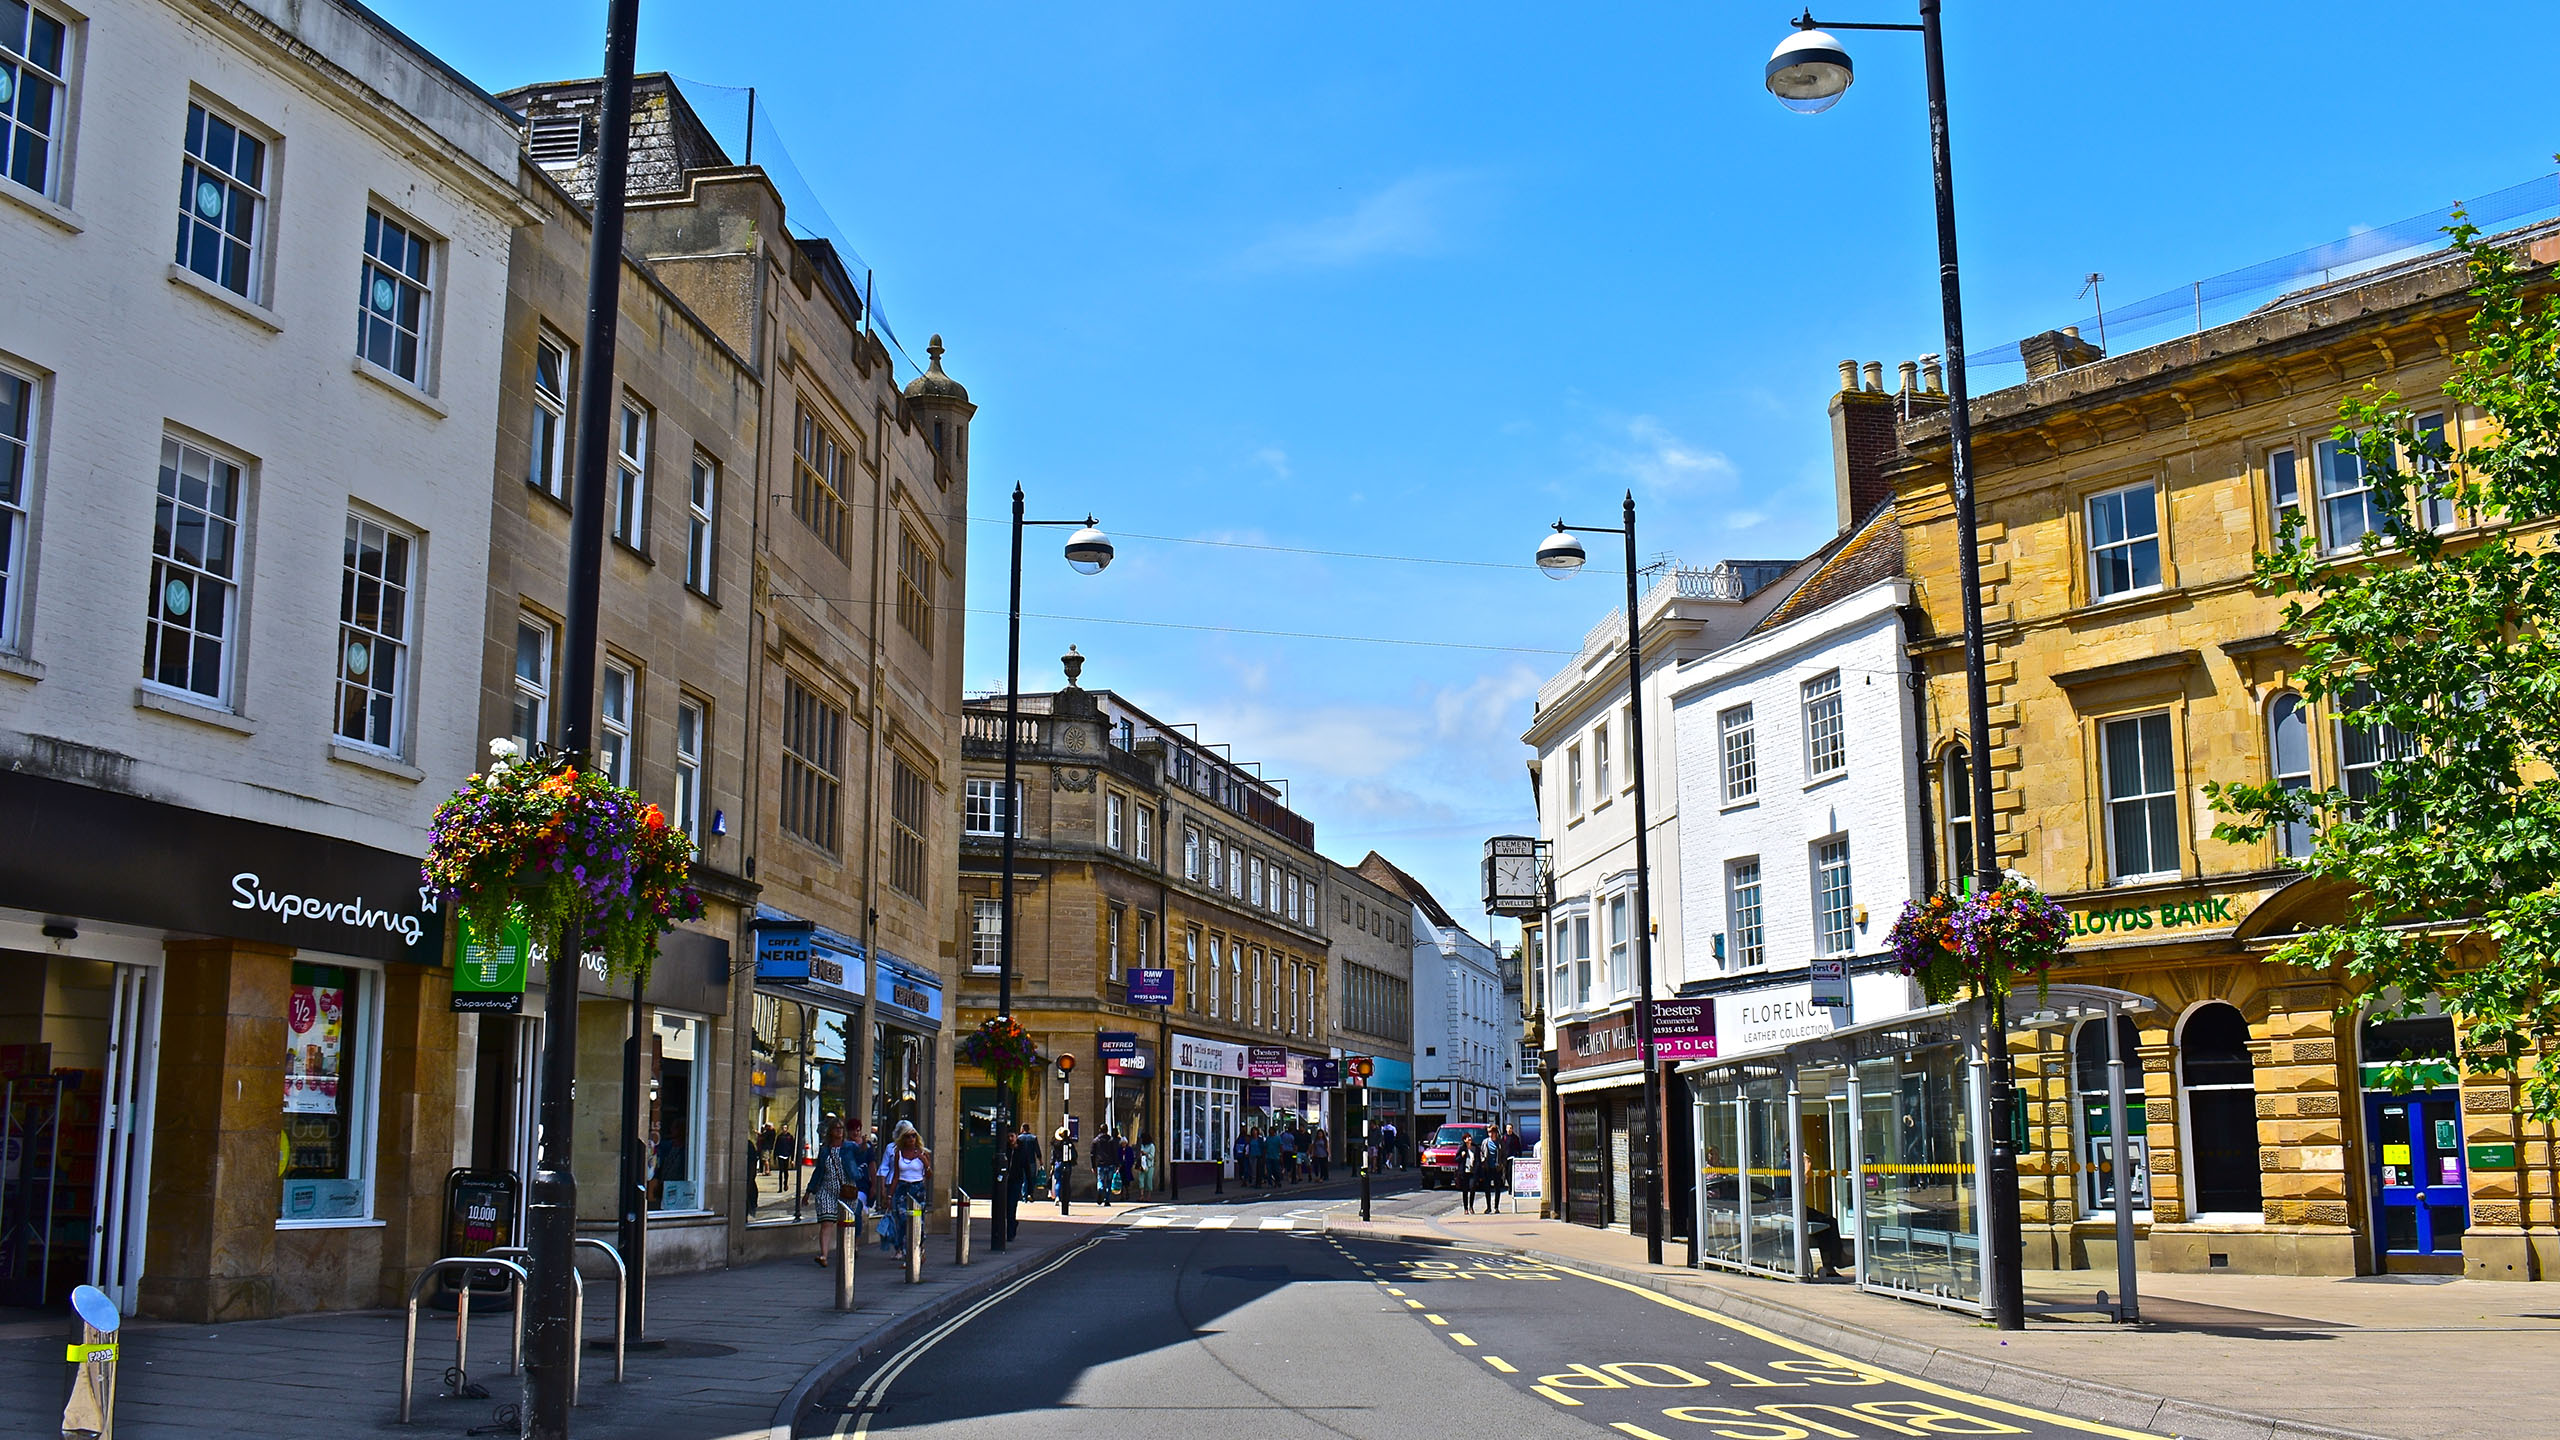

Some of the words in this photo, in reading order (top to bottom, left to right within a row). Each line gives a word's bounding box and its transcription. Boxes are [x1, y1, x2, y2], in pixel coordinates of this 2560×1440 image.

[231, 872, 424, 946] Superdrug
[2160, 897, 2233, 928] BANK
[760, 951, 808, 961] NERO
[1143, 970, 1163, 978] RMW
[1812, 964, 1829, 972] First
[454, 998, 513, 1010] Superdrug
[1656, 1017, 1695, 1025] Commercial
[1687, 1025, 1699, 1033] 454
[1744, 1030, 1777, 1043] LEATHER
[1780, 1024, 1829, 1039] COLLECTION
[1576, 1030, 1611, 1058] CLEMENT
[1675, 1040, 1691, 1050] To
[1695, 1039, 1714, 1050] Let
[468, 1205, 497, 1221] 10,000
[1537, 1360, 1886, 1390] STOP
[1660, 1400, 2033, 1440] BUS
